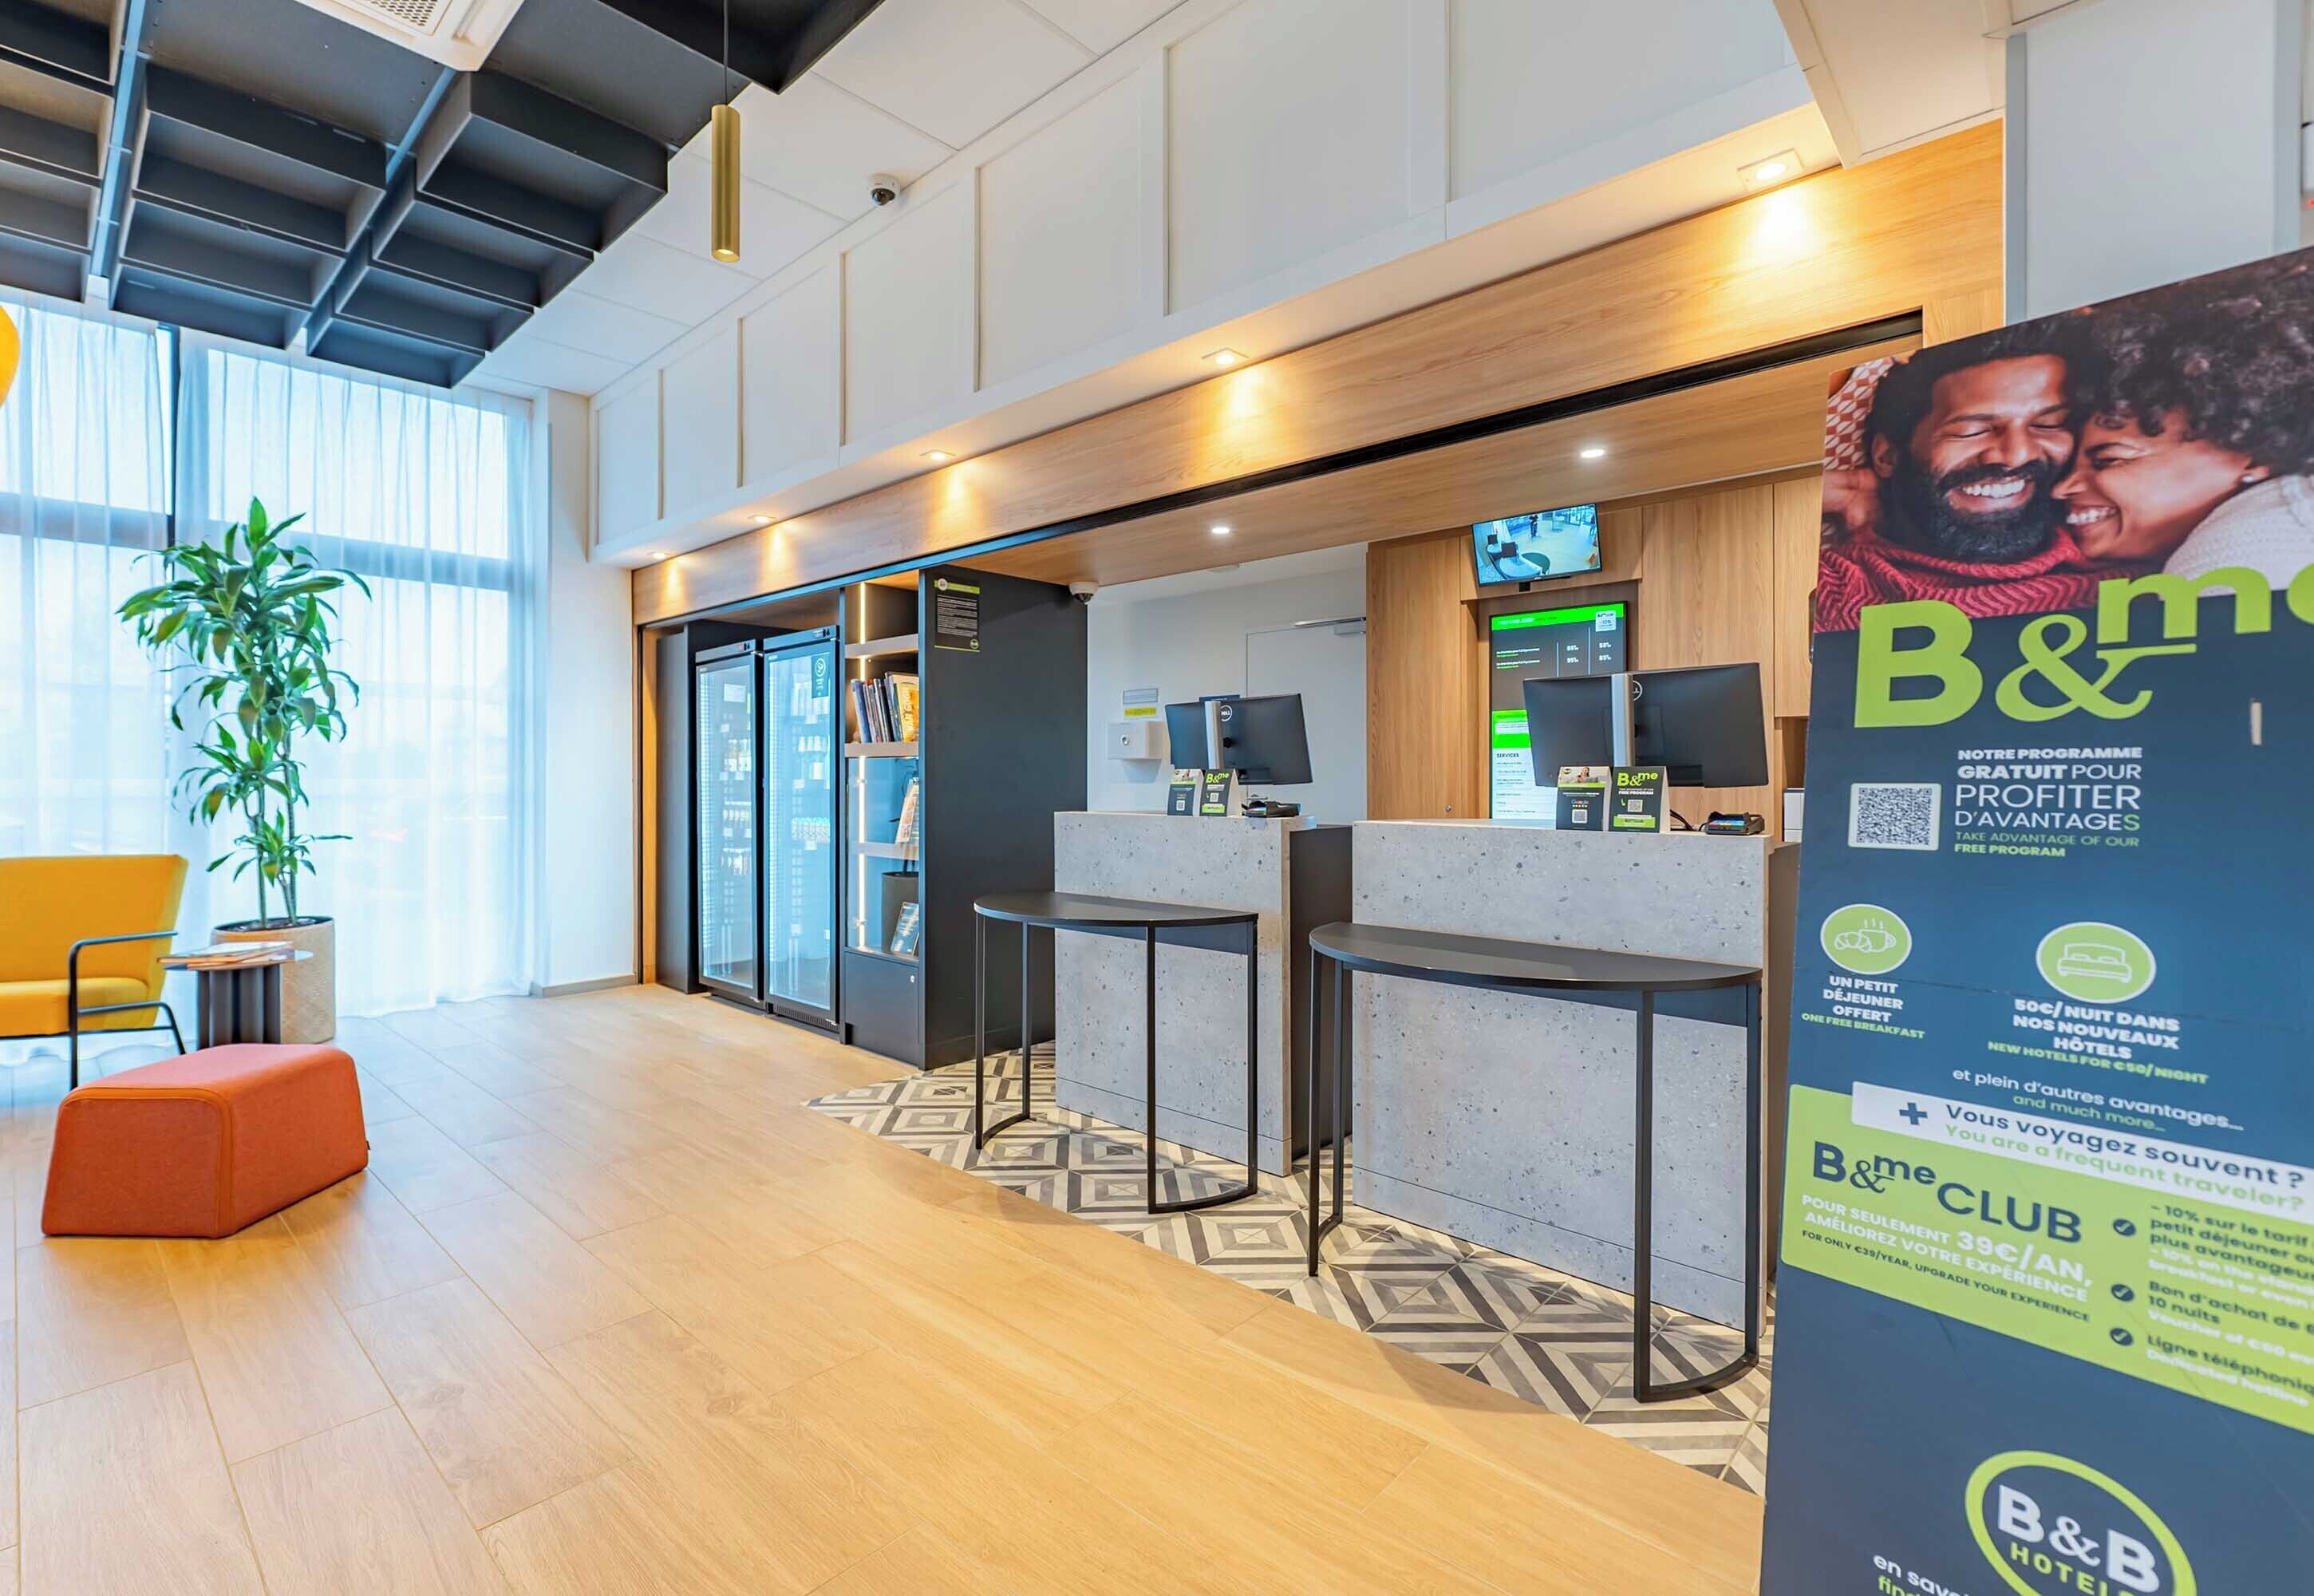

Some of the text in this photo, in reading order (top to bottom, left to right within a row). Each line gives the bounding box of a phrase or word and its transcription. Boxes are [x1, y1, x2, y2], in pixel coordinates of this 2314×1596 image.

[1957, 747, 2143, 760] NOTRE PROGRAMME
[1617, 771, 1658, 787] B&me
[1957, 764, 2142, 780] GRATUIT POUR
[1956, 784, 2142, 810] PROFITER
[1954, 811, 2140, 832] D'AVANTAGES
[1954, 843, 2066, 857] FREE PROGRAM
[1956, 832, 2139, 847] TAKE ADVANTAGE OF OUR
[1829, 975, 1898, 994] UN PETIT
[1822, 988, 1904, 1010] DÉJEUNER
[1801, 1013, 1925, 1039] ONE FREE BREAKFAST
[1832, 1005, 1892, 1022] OFFERT
[2116, 1011, 2180, 1031] DANS
[2012, 1014, 2180, 1049] NOS NOUVEAUX
[1988, 1041, 2021, 1055] NEW
[2023, 1046, 2079, 1064] HOTELS
[2079, 1055, 2111, 1069] FOR
[2053, 1036, 2132, 1059] HÔTELS
[1953, 1069, 1971, 1081] et
[1974, 1072, 2019, 1090] plein
[2024, 1080, 2104, 1106] d'autres
[2013, 1094, 2046, 1109] and
[2050, 1101, 2101, 1120] much
[1946, 1104, 2304, 1188] Vous voyagez souvent ?
[1945, 1123, 2304, 1211] You are a frequent traveler?
[1813, 1140, 2082, 1243] B&me CLUB
[1802, 1194, 1846, 1216] POUR
[1850, 1207, 1951, 1244] SEULEMENT
[2205, 1216, 2237, 1230] sur
[2241, 1223, 2258, 1235] le
[2263, 1229, 2308, 1247] tarif
[2150, 1219, 2194, 1237] petit
[2198, 1230, 2290, 1258] déjeuner
[1805, 1211, 2088, 1302] AMÉLIOREZ VOTRE EXPÉRIENCE
[2150, 1234, 2314, 1282] plus avantageu
[1802, 1230, 1822, 1242] FOR
[1824, 1236, 1852, 1250] ONLY
[1915, 1263, 1971, 1287] UPGRADE
[1973, 1279, 2008, 1297] YOUR
[2010, 1291, 2090, 1322] EXPERIENCE
[2149, 1280, 2185, 1299] Bon
[2273, 1315, 2300, 1329] de
[2149, 1294, 2220, 1325] 10 nuits
[2147, 1334, 2198, 1358] Ligne
[1998, 1484, 2160, 1593] B&B
[1873, 1555, 1902, 1578] en
[2010, 1541, 2136, 1596] HOTEL
